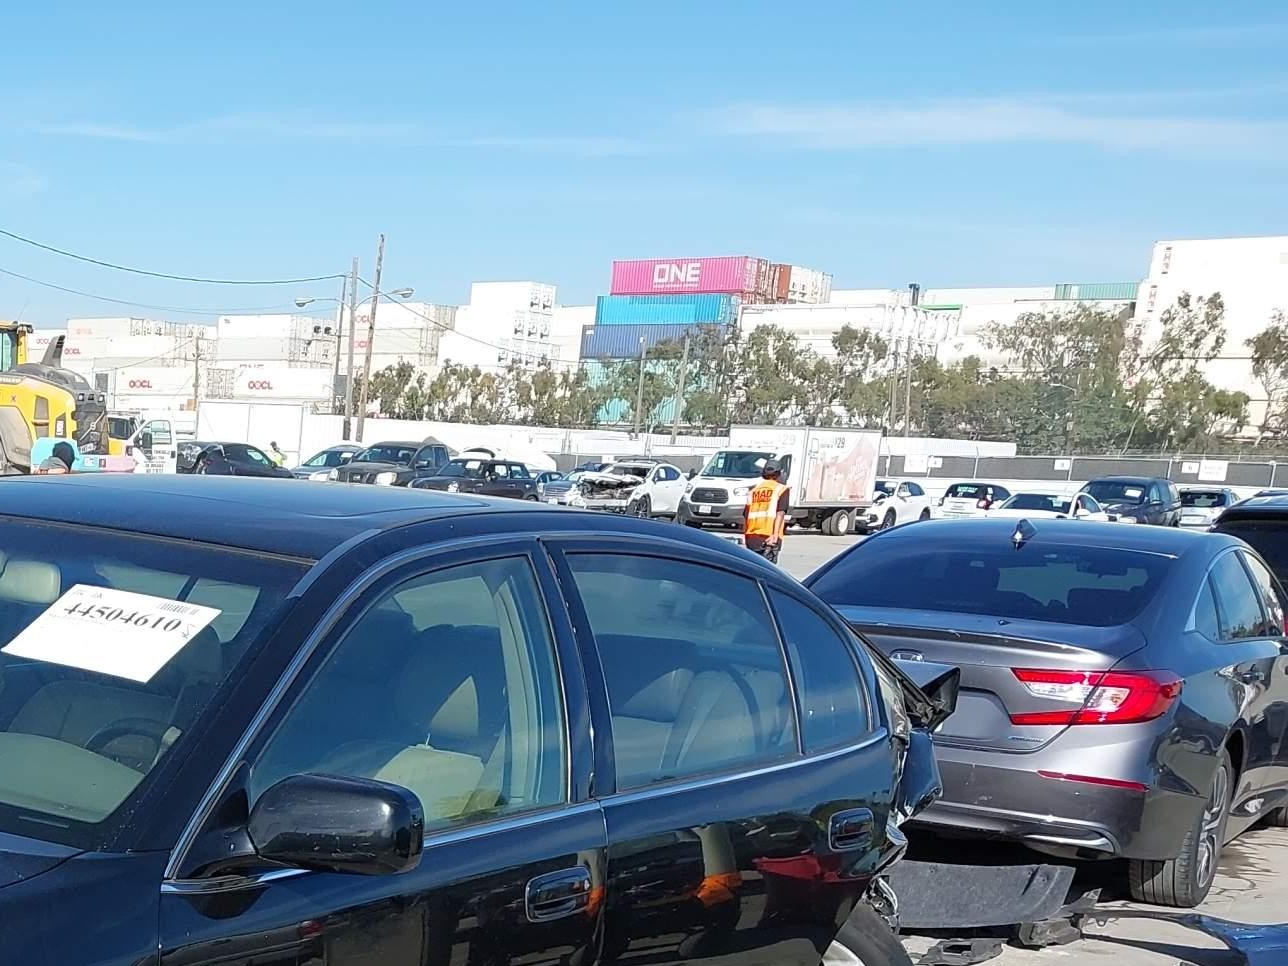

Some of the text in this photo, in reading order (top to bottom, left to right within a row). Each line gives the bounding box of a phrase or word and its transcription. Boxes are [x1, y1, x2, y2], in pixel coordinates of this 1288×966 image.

[653, 263, 701, 282] ONE
[129, 379, 153, 389] OOCL
[248, 380, 273, 390] OOCL
[752, 489, 774, 499] MAD
[64, 602, 182, 632] 44504610
